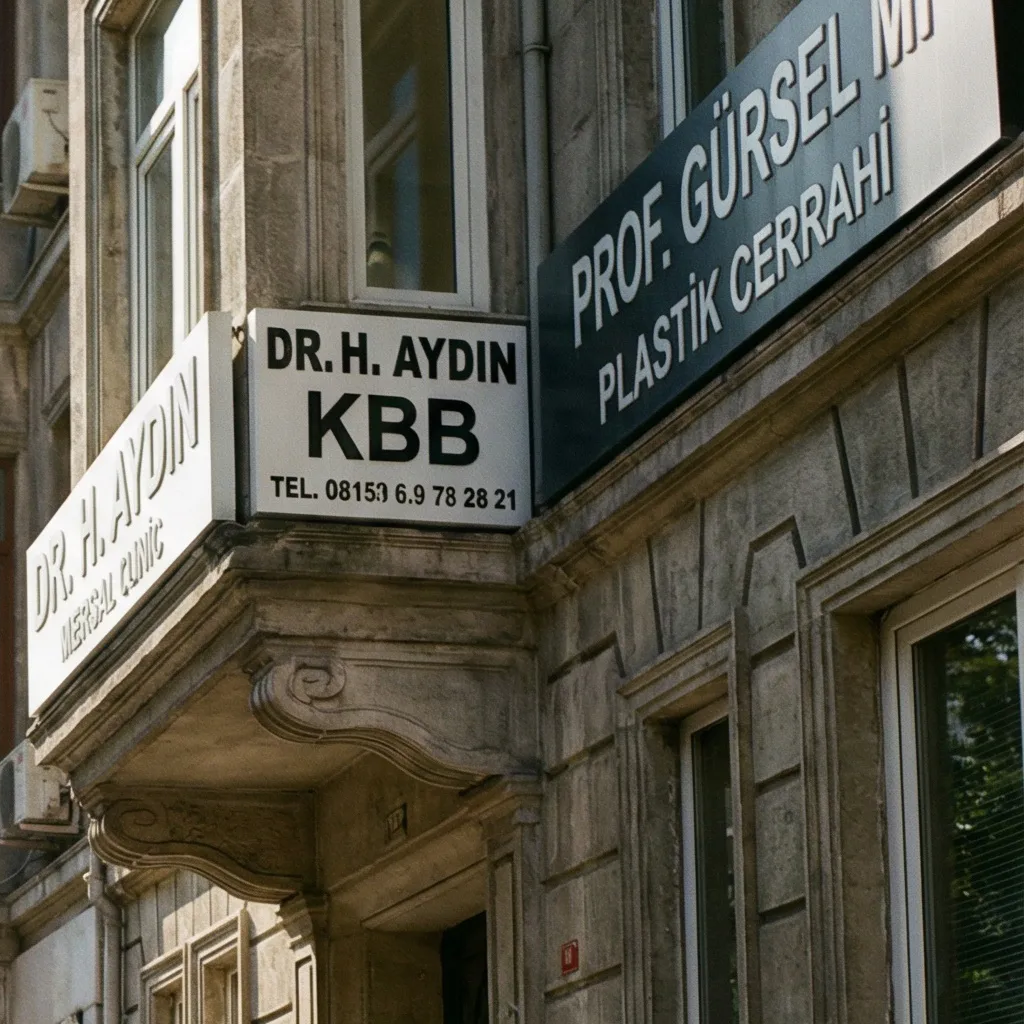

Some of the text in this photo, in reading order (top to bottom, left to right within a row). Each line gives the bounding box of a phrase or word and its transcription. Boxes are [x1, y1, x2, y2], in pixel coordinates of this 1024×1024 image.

[571, 182, 671, 350] PROF.
[680, 13, 860, 245] GÜRSEL
[598, 105, 893, 425] PLASTİK CERRAHİ
[308, 390, 480, 466] KBB
[392, 335, 517, 385] AYDIN
[33, 355, 199, 632] DR. H. AYDIN
[270, 475, 319, 500] TEL.
[432, 485, 457, 507] 78
[463, 487, 489, 509] 28
[494, 489, 517, 511] 21
